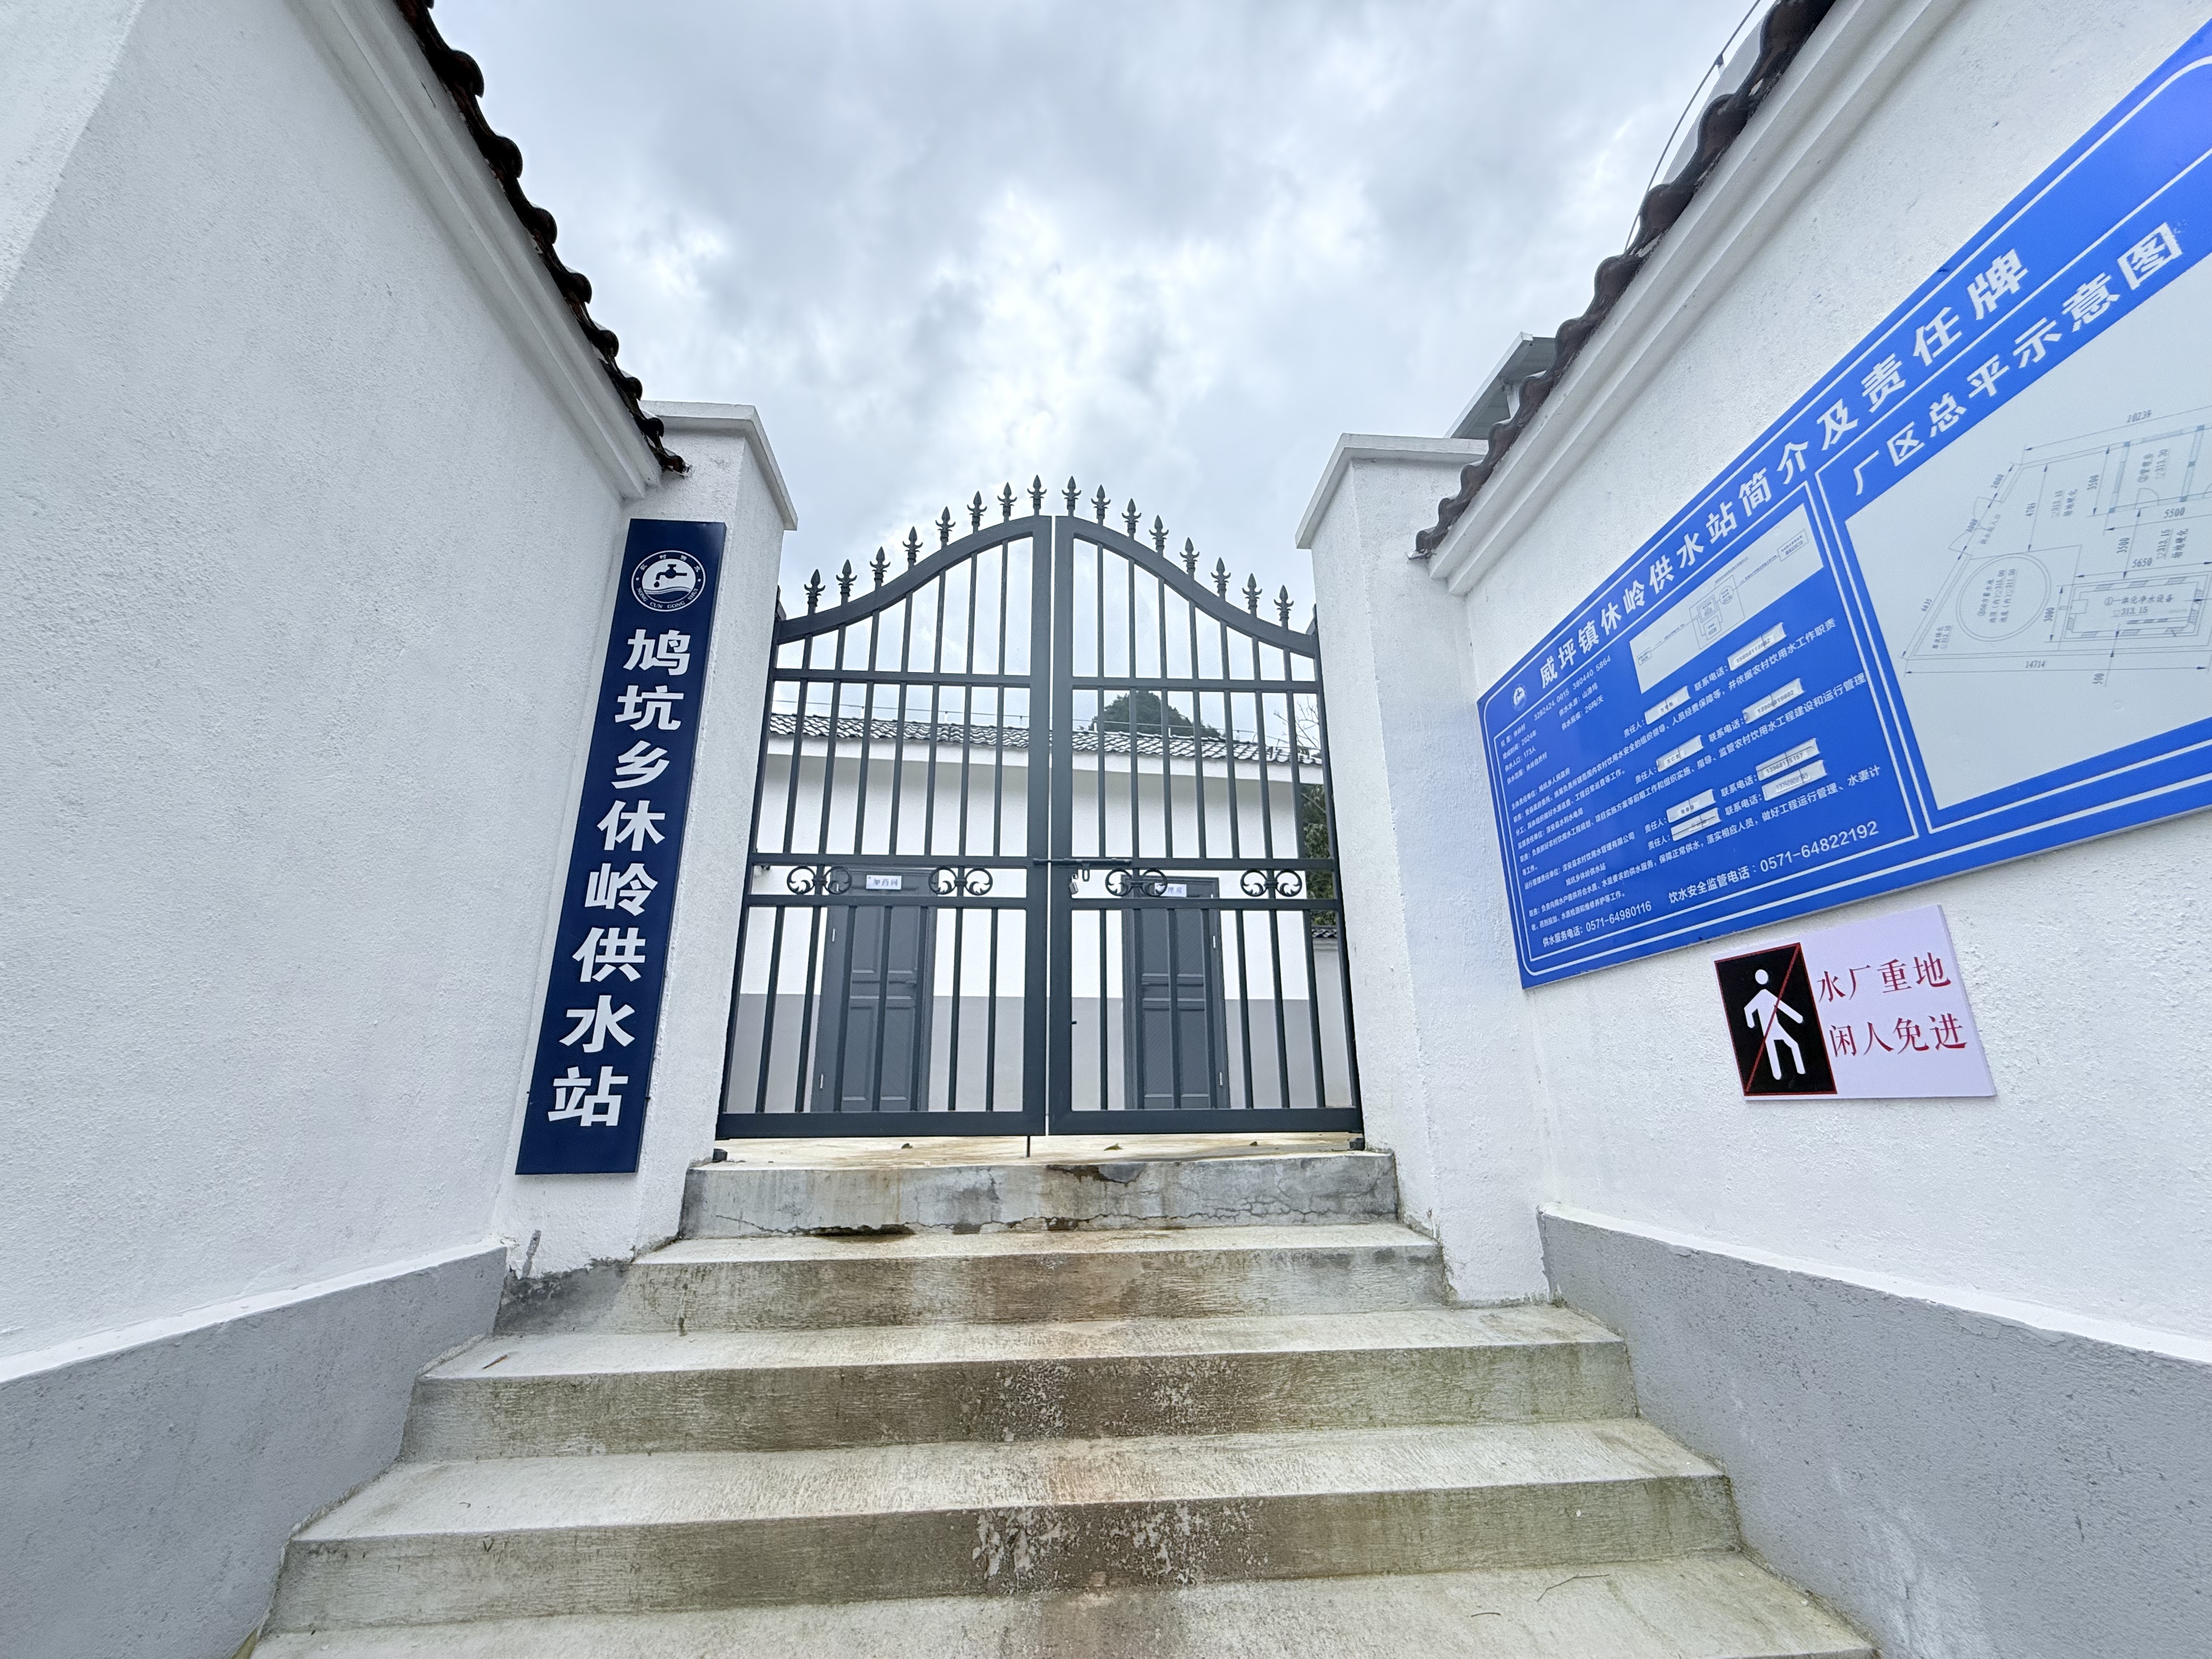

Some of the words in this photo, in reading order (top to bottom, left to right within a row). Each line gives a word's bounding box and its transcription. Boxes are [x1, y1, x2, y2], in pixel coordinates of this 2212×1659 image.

[1853, 222, 2183, 495] 厂区总平示意图
[1540, 249, 2028, 689] 威坪镇休岭供水站简介及责任牌
[2087, 474, 2099, 490] 3500
[2164, 507, 2185, 518] 5500
[2117, 537, 2130, 554] 3500
[2132, 557, 2152, 568] 5650
[636, 587, 648, 602] NONG
[667, 601, 685, 609] GONG
[687, 588, 698, 600] SHUI
[1921, 598, 1933, 612] 6635
[2044, 607, 2055, 622] 3000
[1694, 665, 1729, 691] 联系电话：
[2092, 673, 2104, 685] 500
[1708, 718, 1744, 742] 联系电话：
[1720, 774, 1758, 797] 联系电话：
[1724, 793, 1763, 816] 联系电话：
[1668, 821, 1878, 903] 饮水安全监管电话：0571-64822192
[549, 629, 691, 1126] 鸠坑乡休岭供水站
[1817, 952, 1951, 1002] 水厂重地
[1830, 1013, 1967, 1057] 闲人免进
